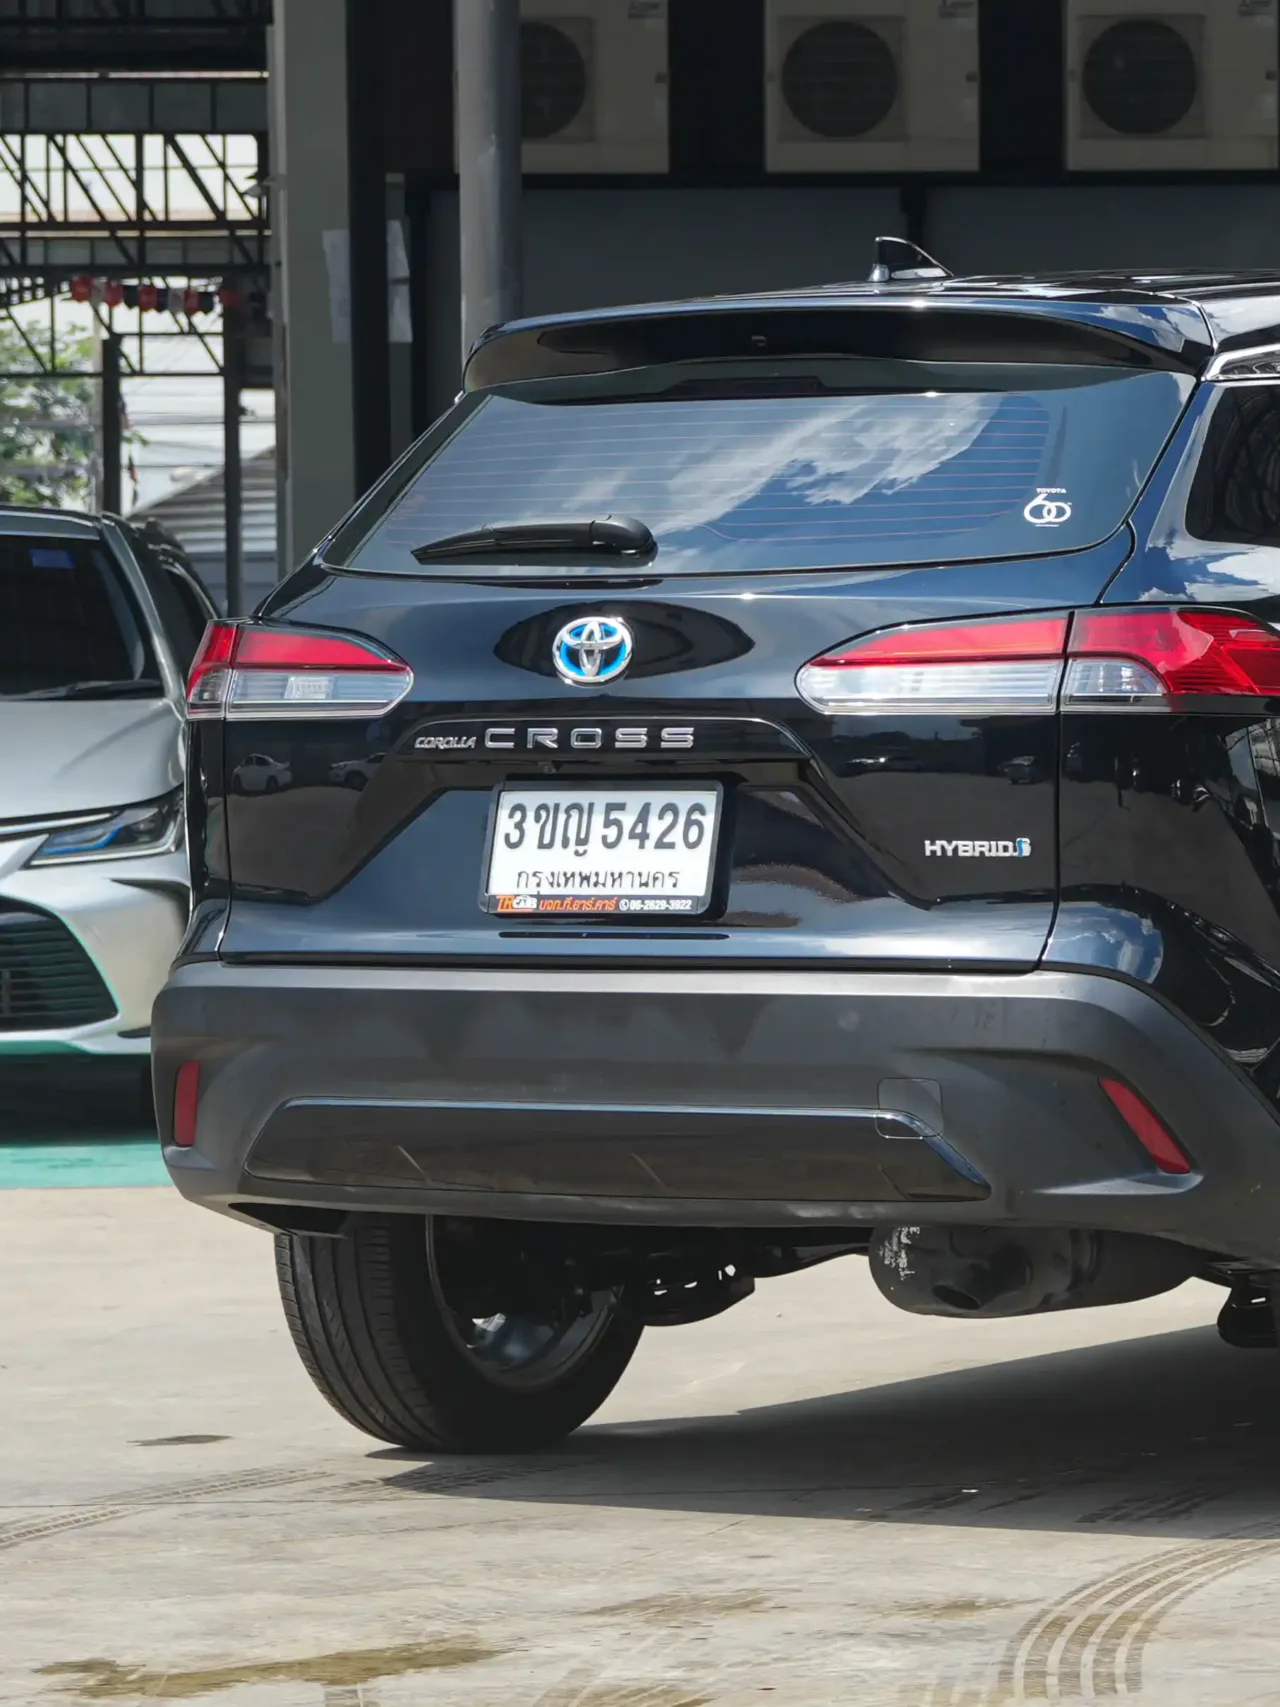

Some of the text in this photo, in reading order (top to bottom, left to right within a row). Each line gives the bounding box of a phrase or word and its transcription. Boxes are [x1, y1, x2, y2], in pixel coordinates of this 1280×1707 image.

[414, 727, 695, 750] COROLLA CROSS
[503, 802, 707, 857] 3ขญ 5426
[924, 839, 1015, 857] HYBRID
[516, 869, 681, 896] กรุงเทพมหานคร
